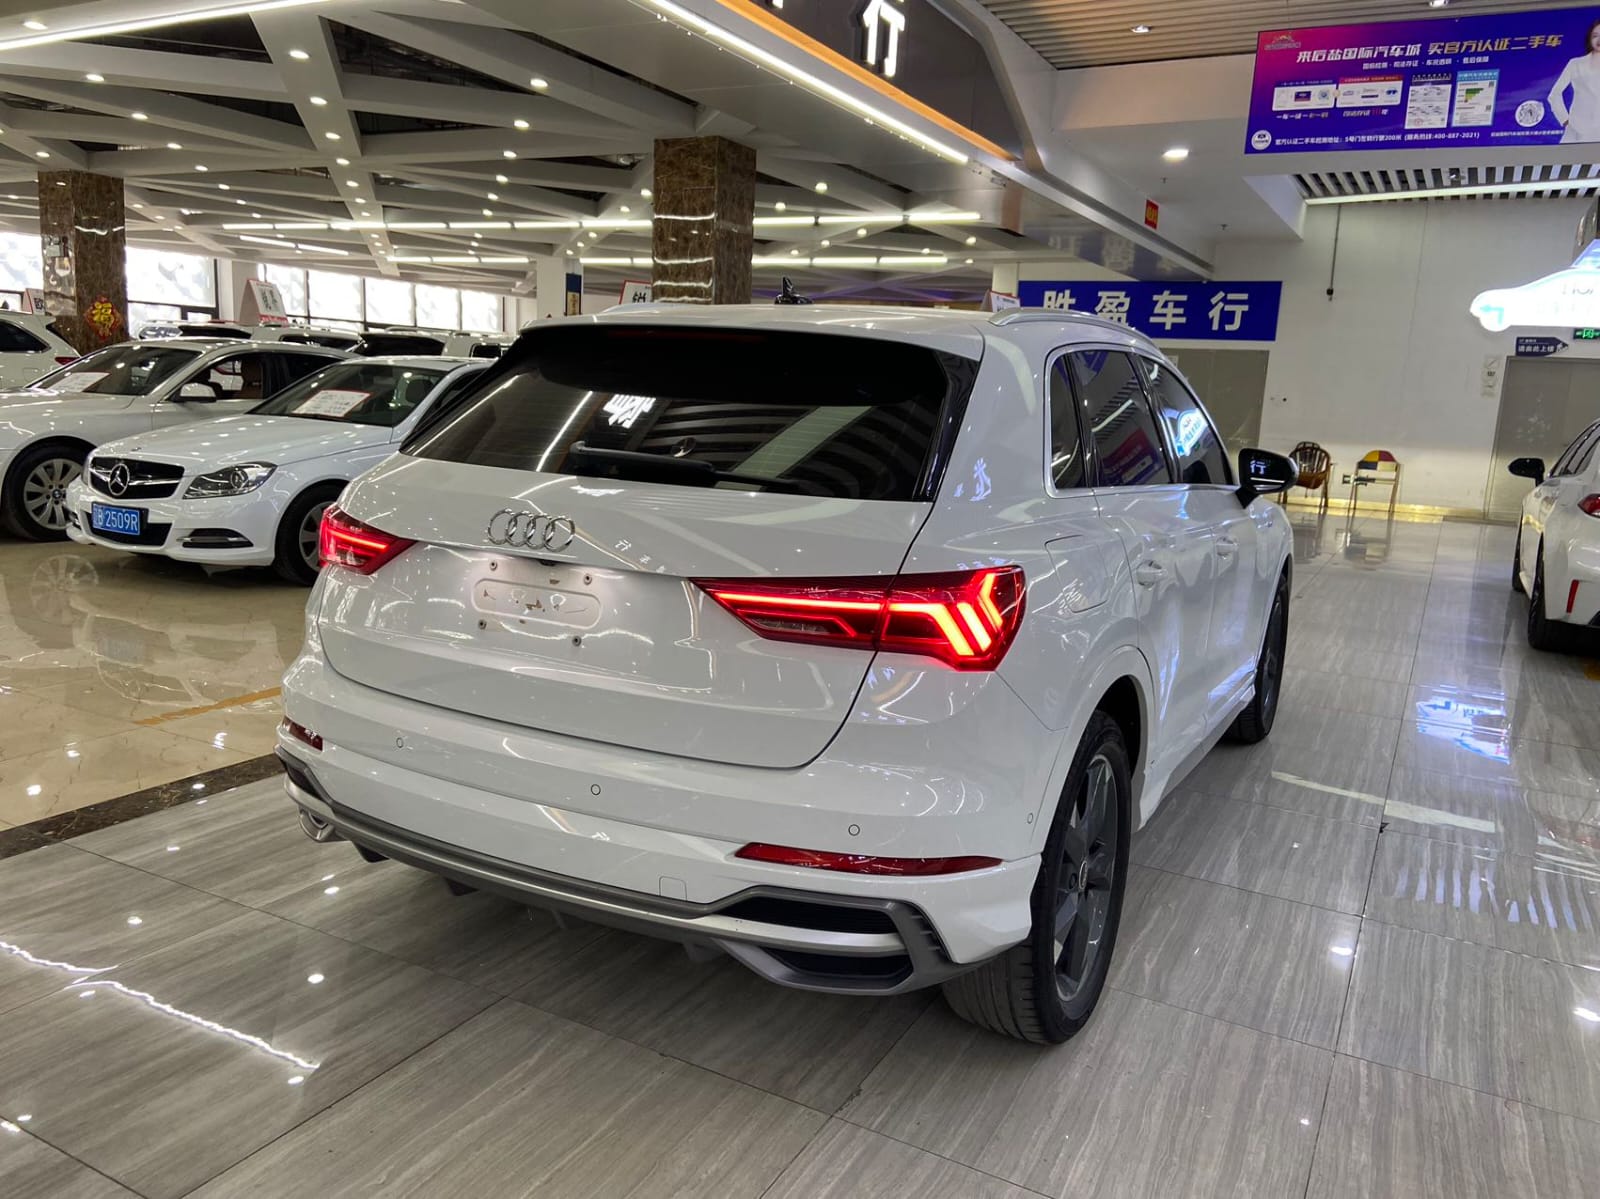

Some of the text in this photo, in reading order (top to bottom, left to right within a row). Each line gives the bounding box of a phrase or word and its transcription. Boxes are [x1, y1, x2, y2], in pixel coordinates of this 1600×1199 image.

[1427, 34, 1564, 56] 买官方认证二手车
[1042, 289, 1250, 331] 胜盈车行
